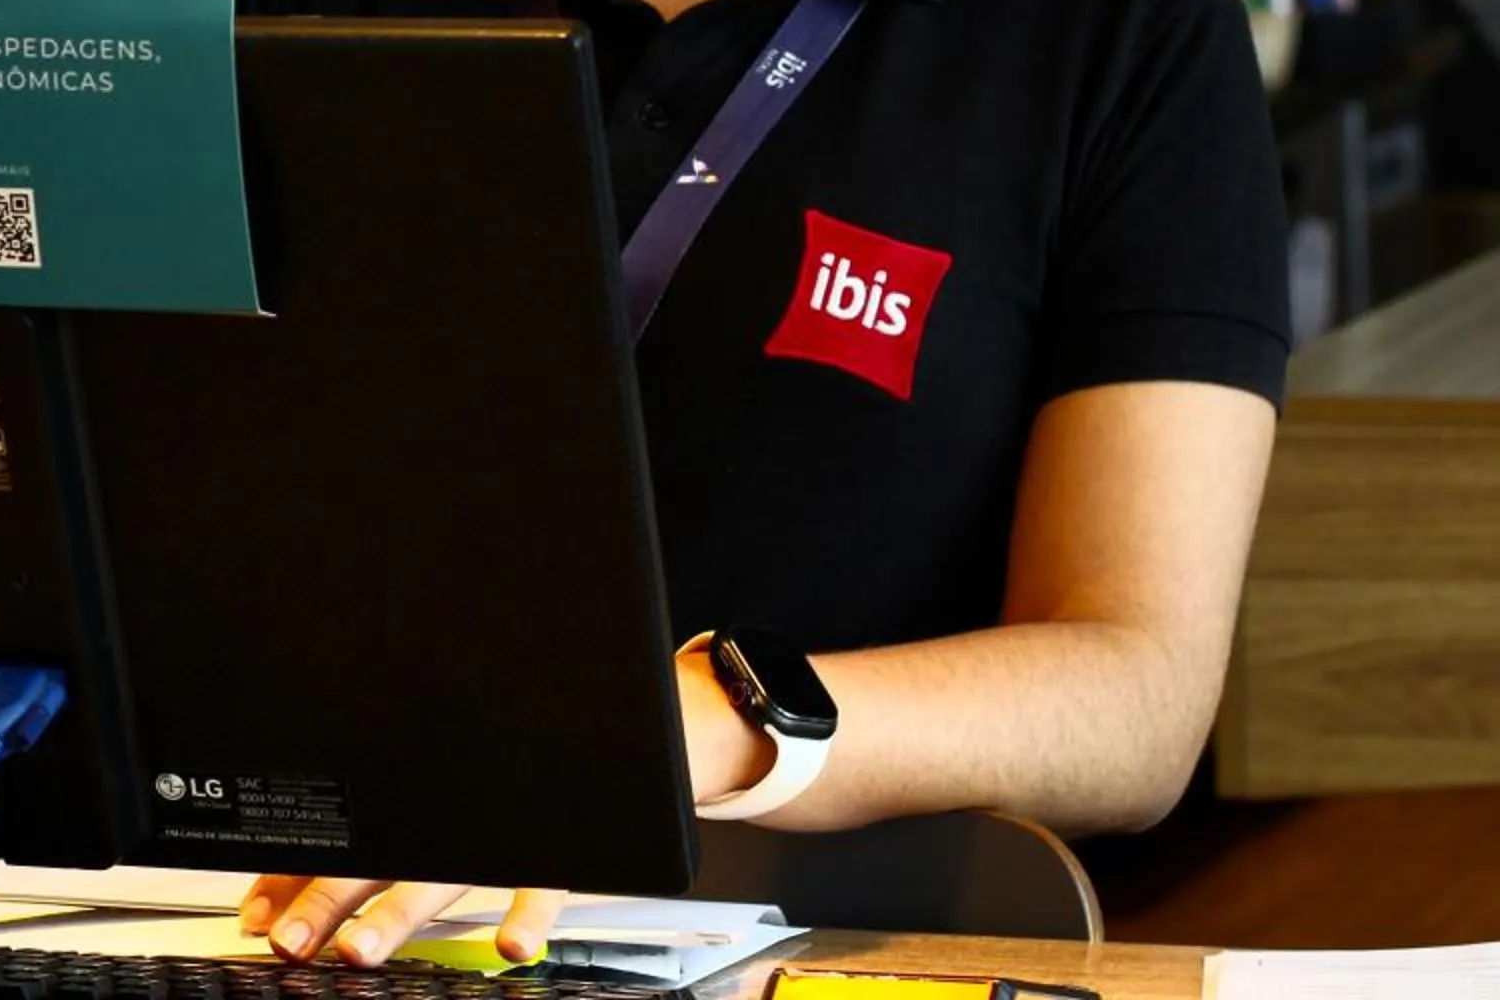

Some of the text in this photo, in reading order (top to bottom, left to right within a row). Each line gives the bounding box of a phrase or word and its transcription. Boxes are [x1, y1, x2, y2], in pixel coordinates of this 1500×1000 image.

[765, 50, 807, 89] ibis
[810, 252, 912, 337] ibis
[190, 777, 224, 799] LG
